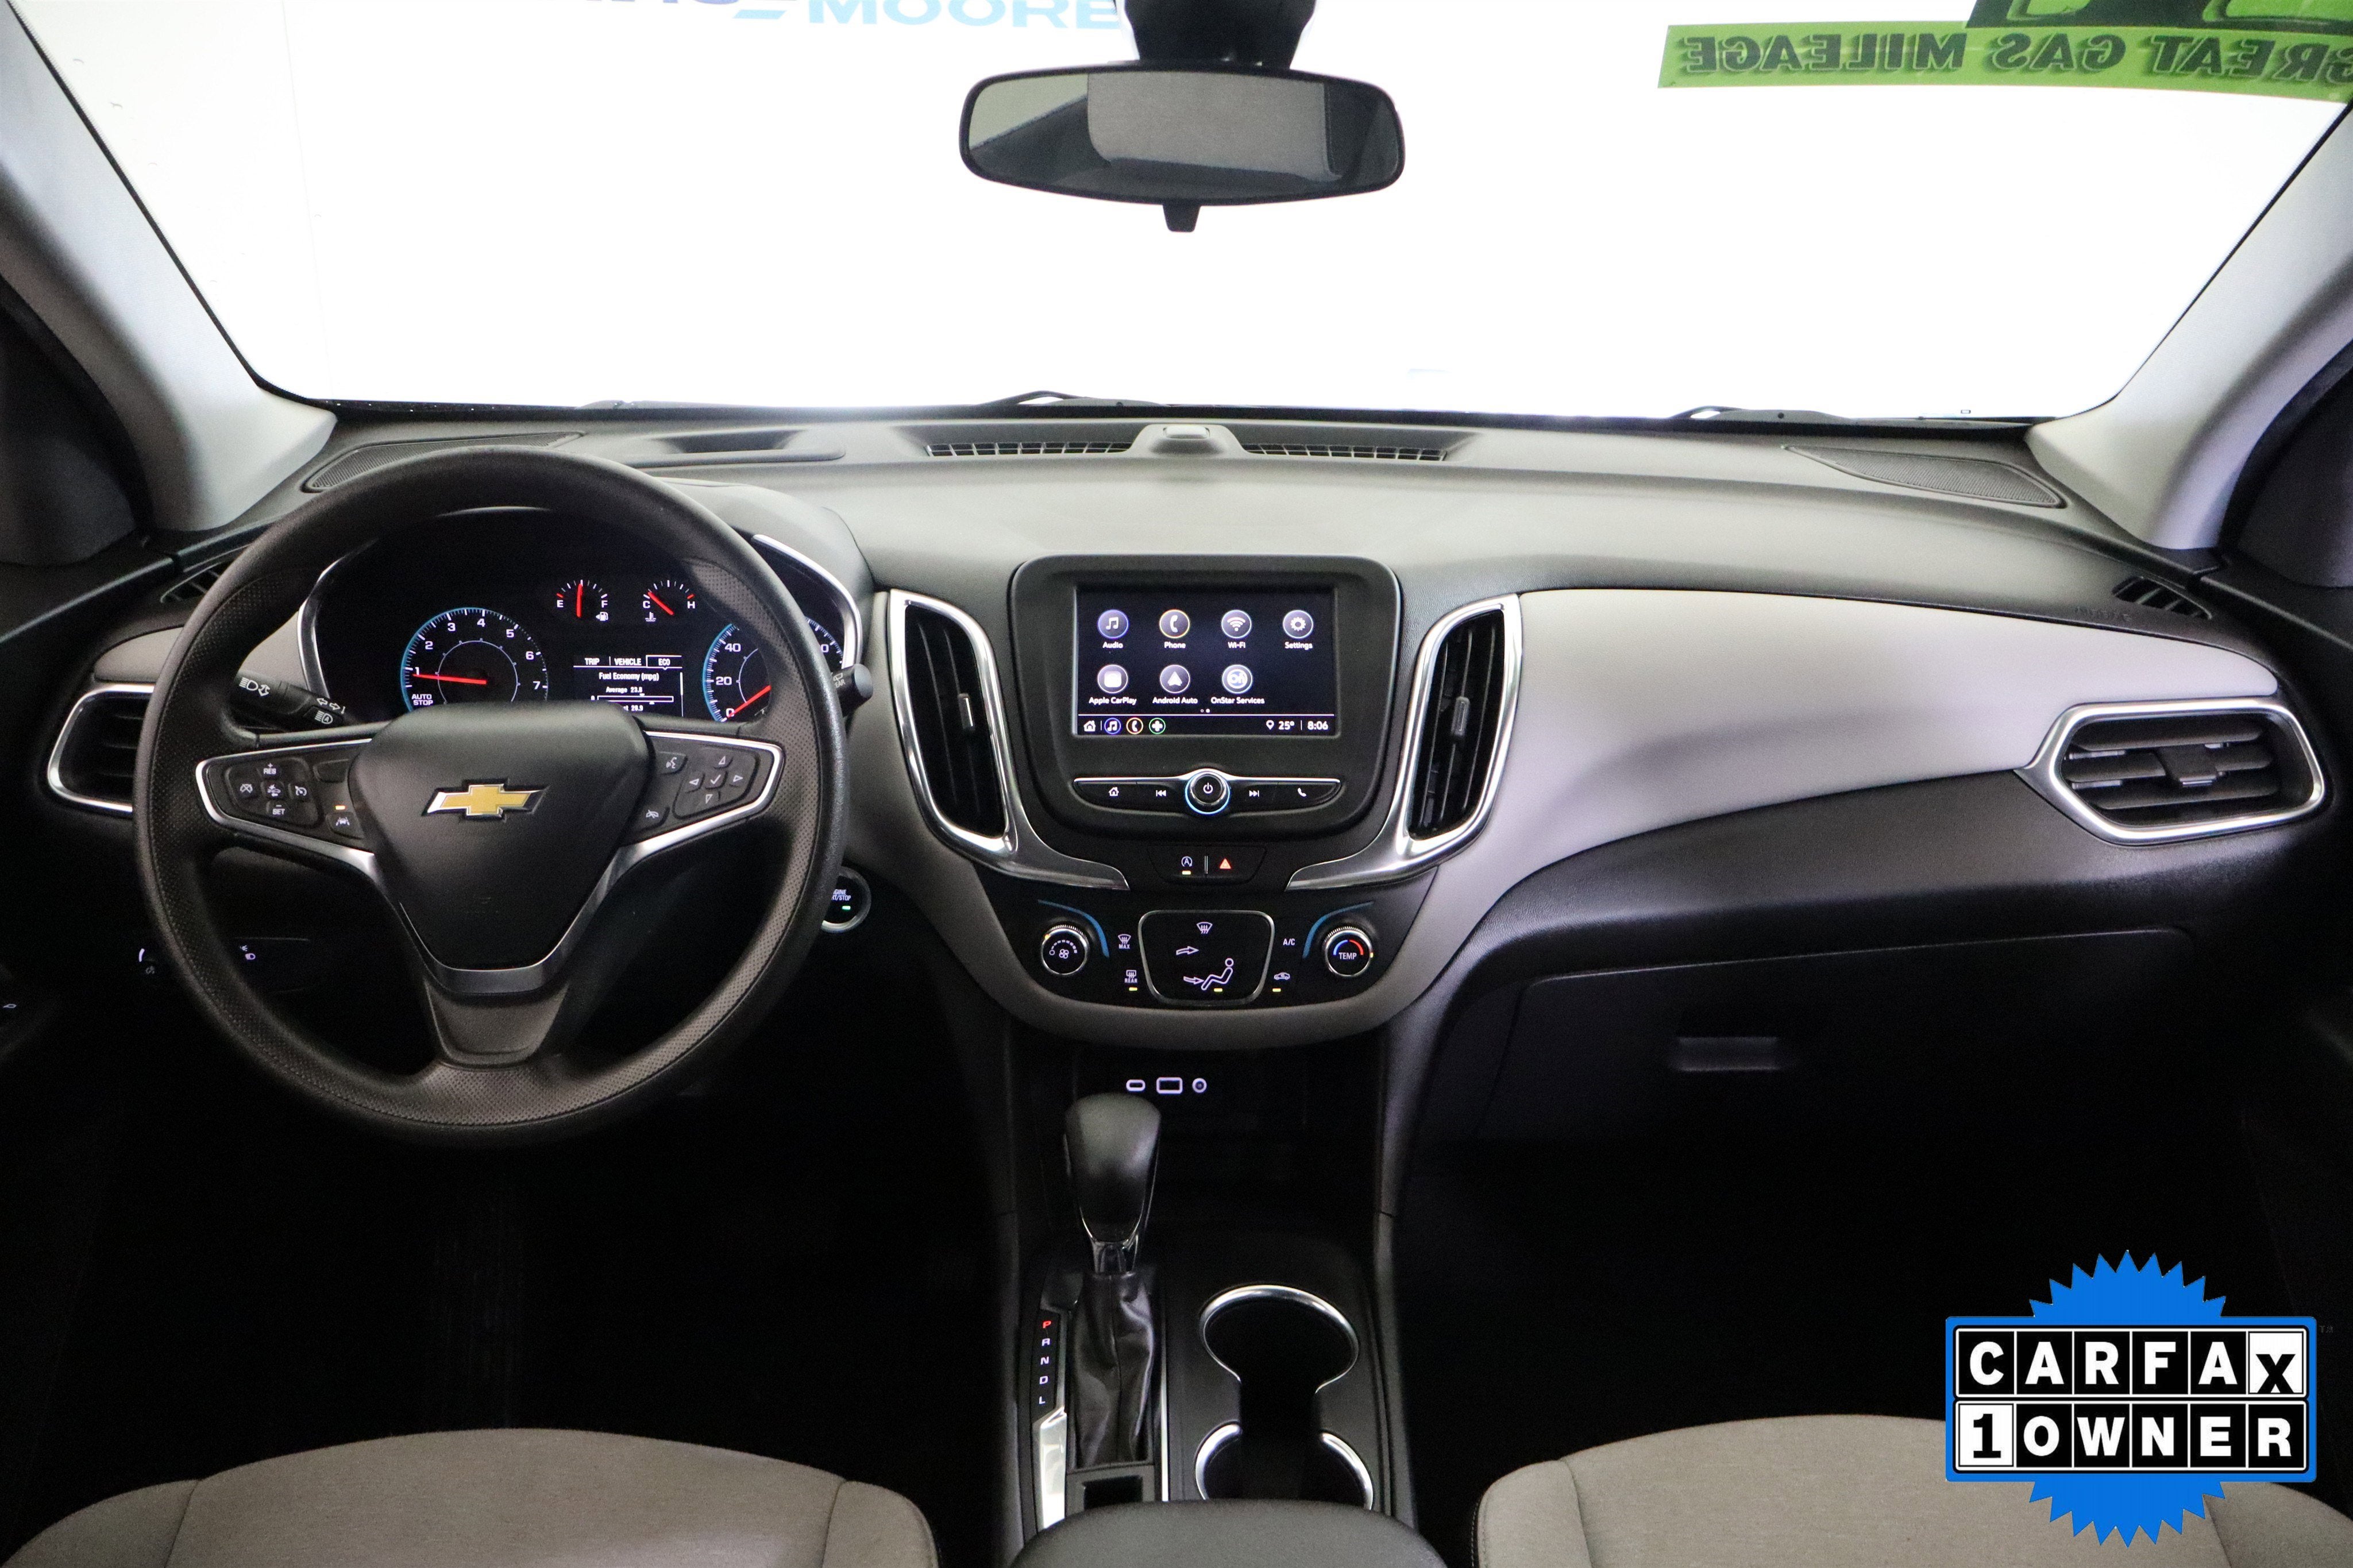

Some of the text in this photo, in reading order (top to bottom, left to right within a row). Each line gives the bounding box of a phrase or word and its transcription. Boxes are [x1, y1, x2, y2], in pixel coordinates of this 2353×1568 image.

[807, 0, 1119, 29] MOORE
[557, 600, 564, 608] E
[601, 600, 608, 608] F
[642, 600, 651, 609] C
[687, 601, 696, 609] H
[447, 622, 456, 632] 3
[477, 618, 486, 627] 4
[506, 629, 515, 638] 5
[425, 641, 434, 650] 2
[724, 643, 741, 652] 40
[1102, 641, 1124, 649] Audio
[1164, 641, 1186, 649] Phone
[1284, 641, 1313, 650] Settings
[525, 651, 534, 661] 6
[584, 658, 600, 666] TRIP
[614, 658, 642, 666] VEHICLE
[658, 658, 671, 666] ECO
[415, 666, 420, 675] 1
[599, 672, 659, 682] Fuel Economy (mpg)
[716, 676, 732, 686] 20
[533, 681, 541, 690] 7
[835, 679, 846, 688] EAR
[605, 686, 628, 694] Average
[1087, 696, 1137, 706] Apple CarPlay
[1152, 696, 1180, 704] Android
[1210, 696, 1265, 704] OnStar Services
[1307, 720, 1329, 730] 8:06
[1283, 938, 1295, 946] A/C
[1339, 952, 1357, 960] TEMP
[1042, 1320, 1052, 1328] P
[1040, 1356, 1050, 1365] N
[1039, 1376, 1048, 1385] D
[1039, 1396, 1046, 1405] L
